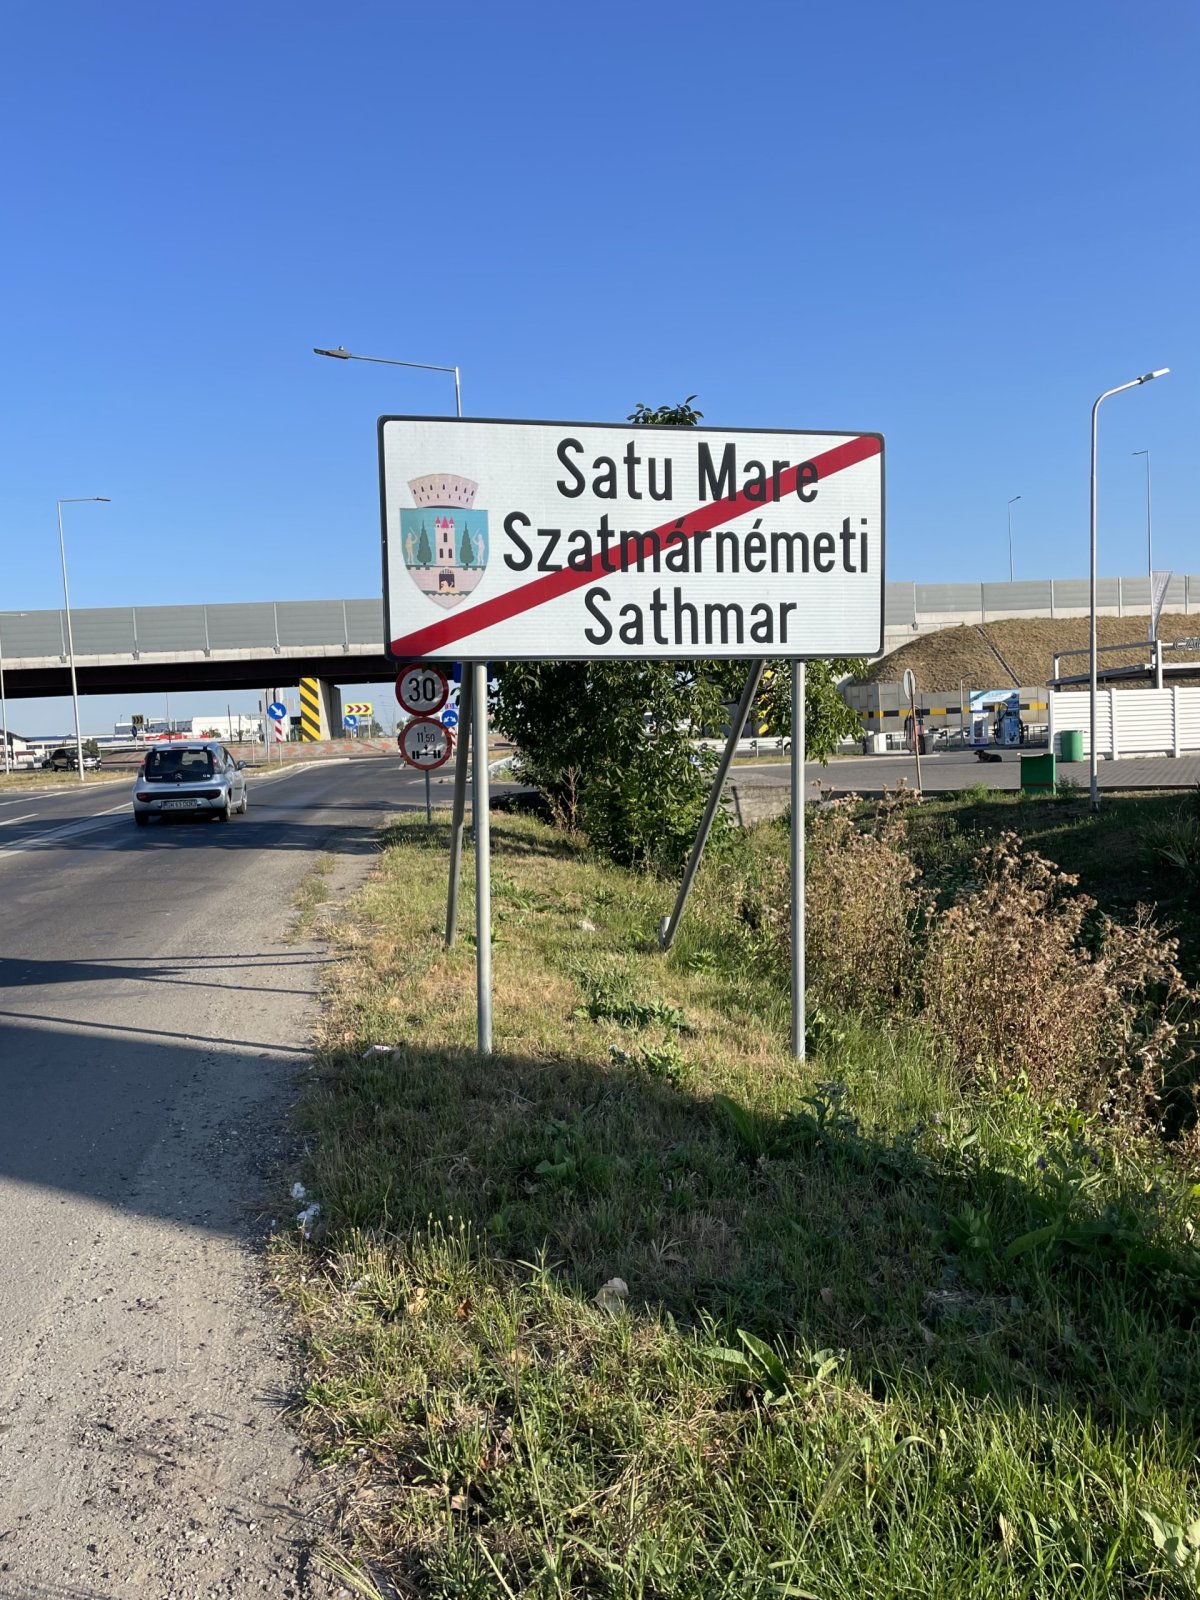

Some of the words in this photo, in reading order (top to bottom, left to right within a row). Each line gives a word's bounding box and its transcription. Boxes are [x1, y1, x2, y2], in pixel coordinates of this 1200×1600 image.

[556, 438, 672, 501] Satu
[698, 442, 819, 503] Mare
[503, 511, 868, 574] Szatmárnémeti
[584, 587, 797, 645] Sathmar
[408, 677, 436, 702] 30
